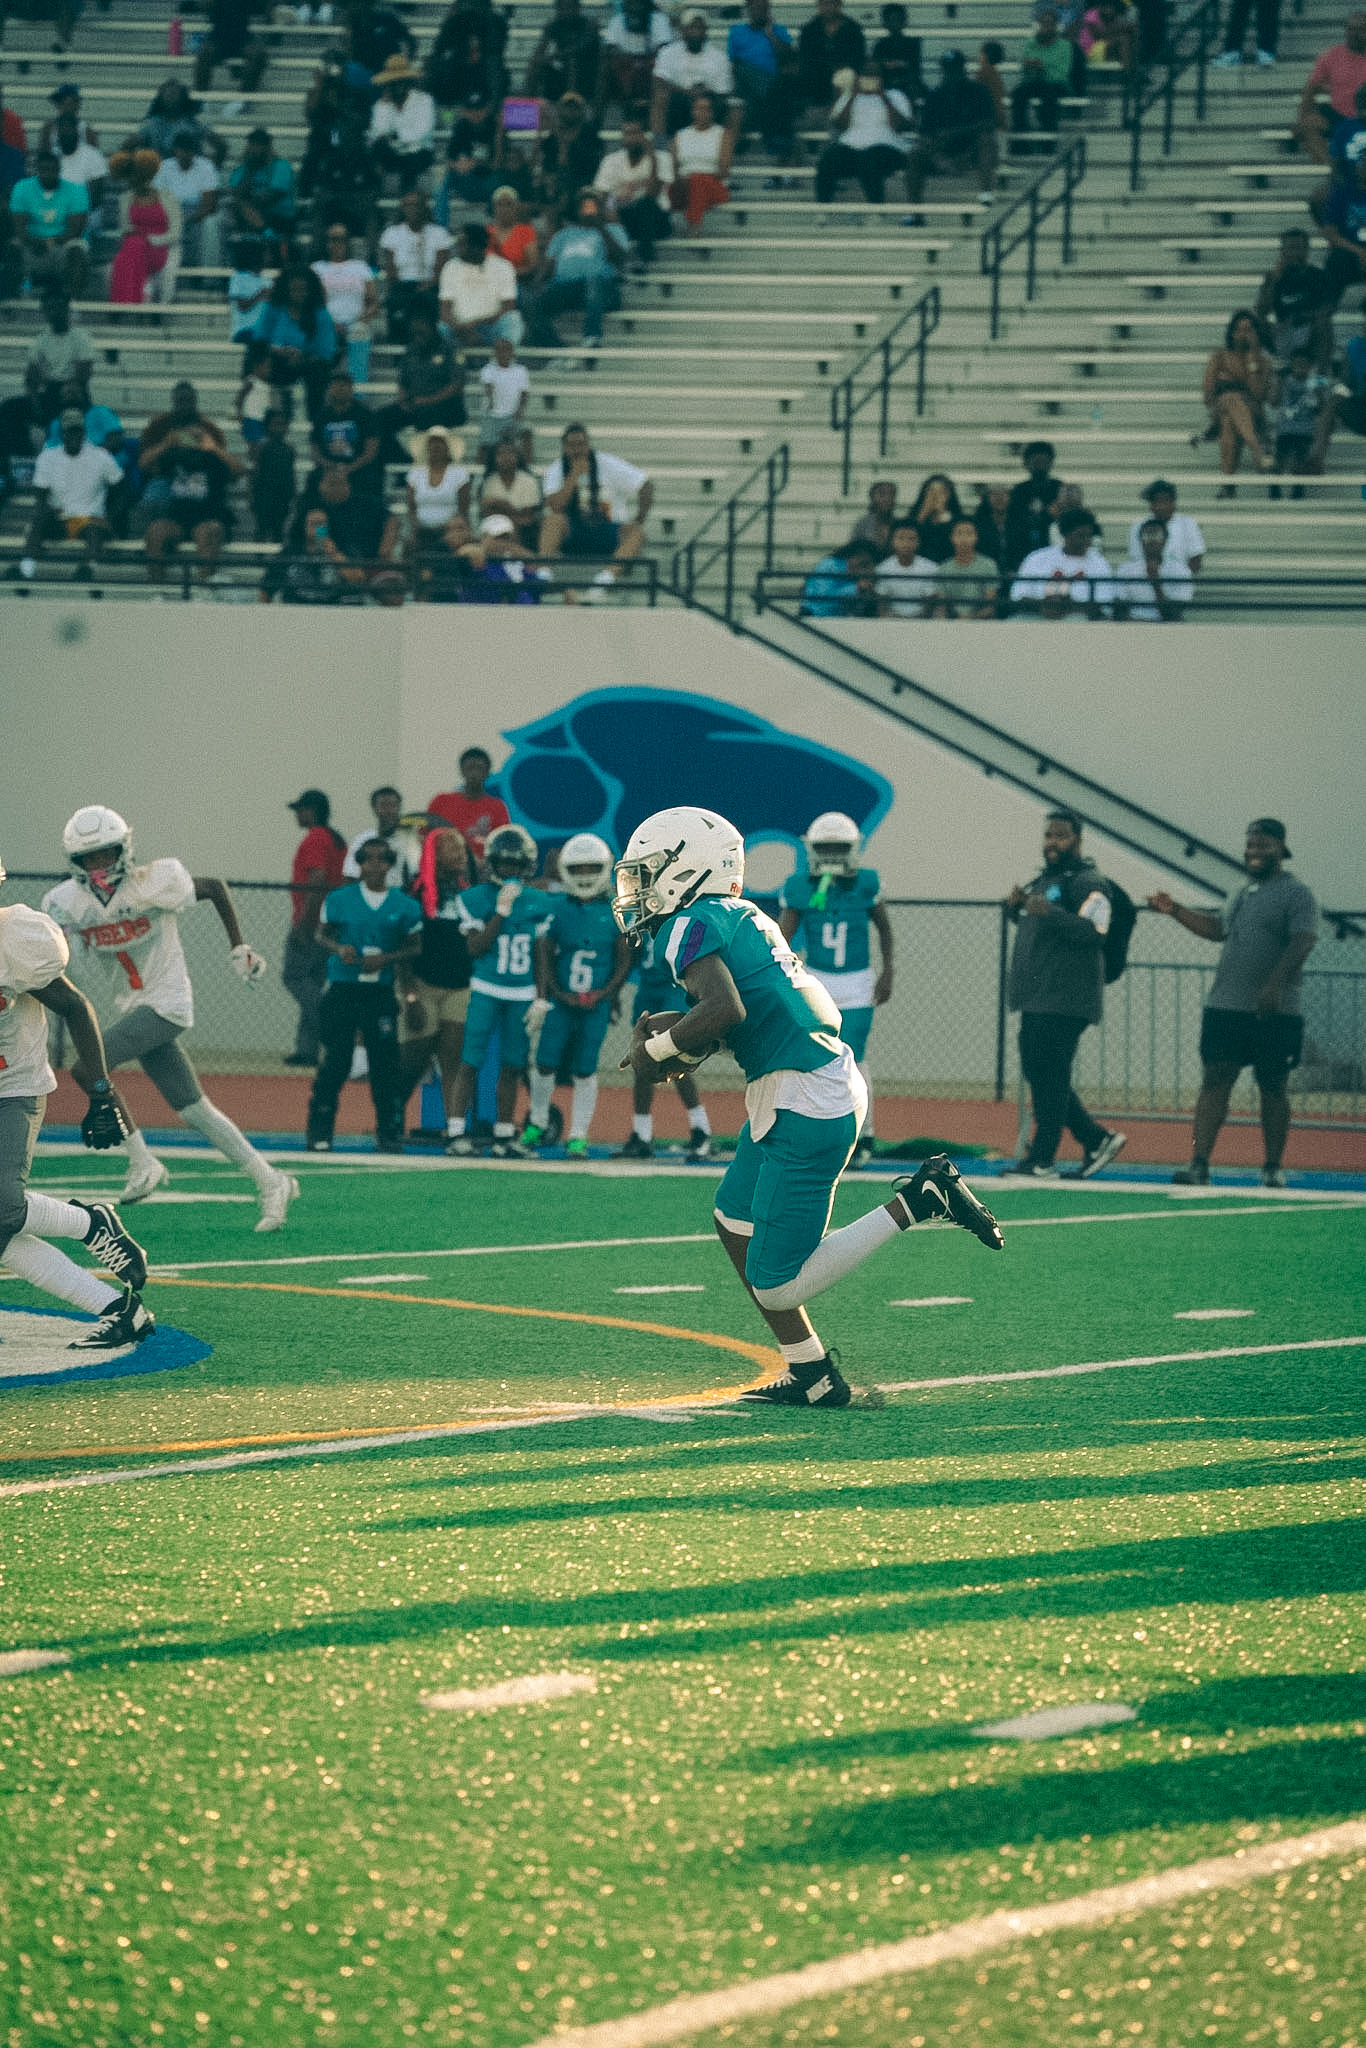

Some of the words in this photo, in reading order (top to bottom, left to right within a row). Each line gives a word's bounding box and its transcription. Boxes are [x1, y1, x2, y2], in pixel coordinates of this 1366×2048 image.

[496, 933, 531, 975] 18
[822, 921, 848, 968] 4
[116, 950, 143, 990] 1
[569, 950, 597, 993] 6
